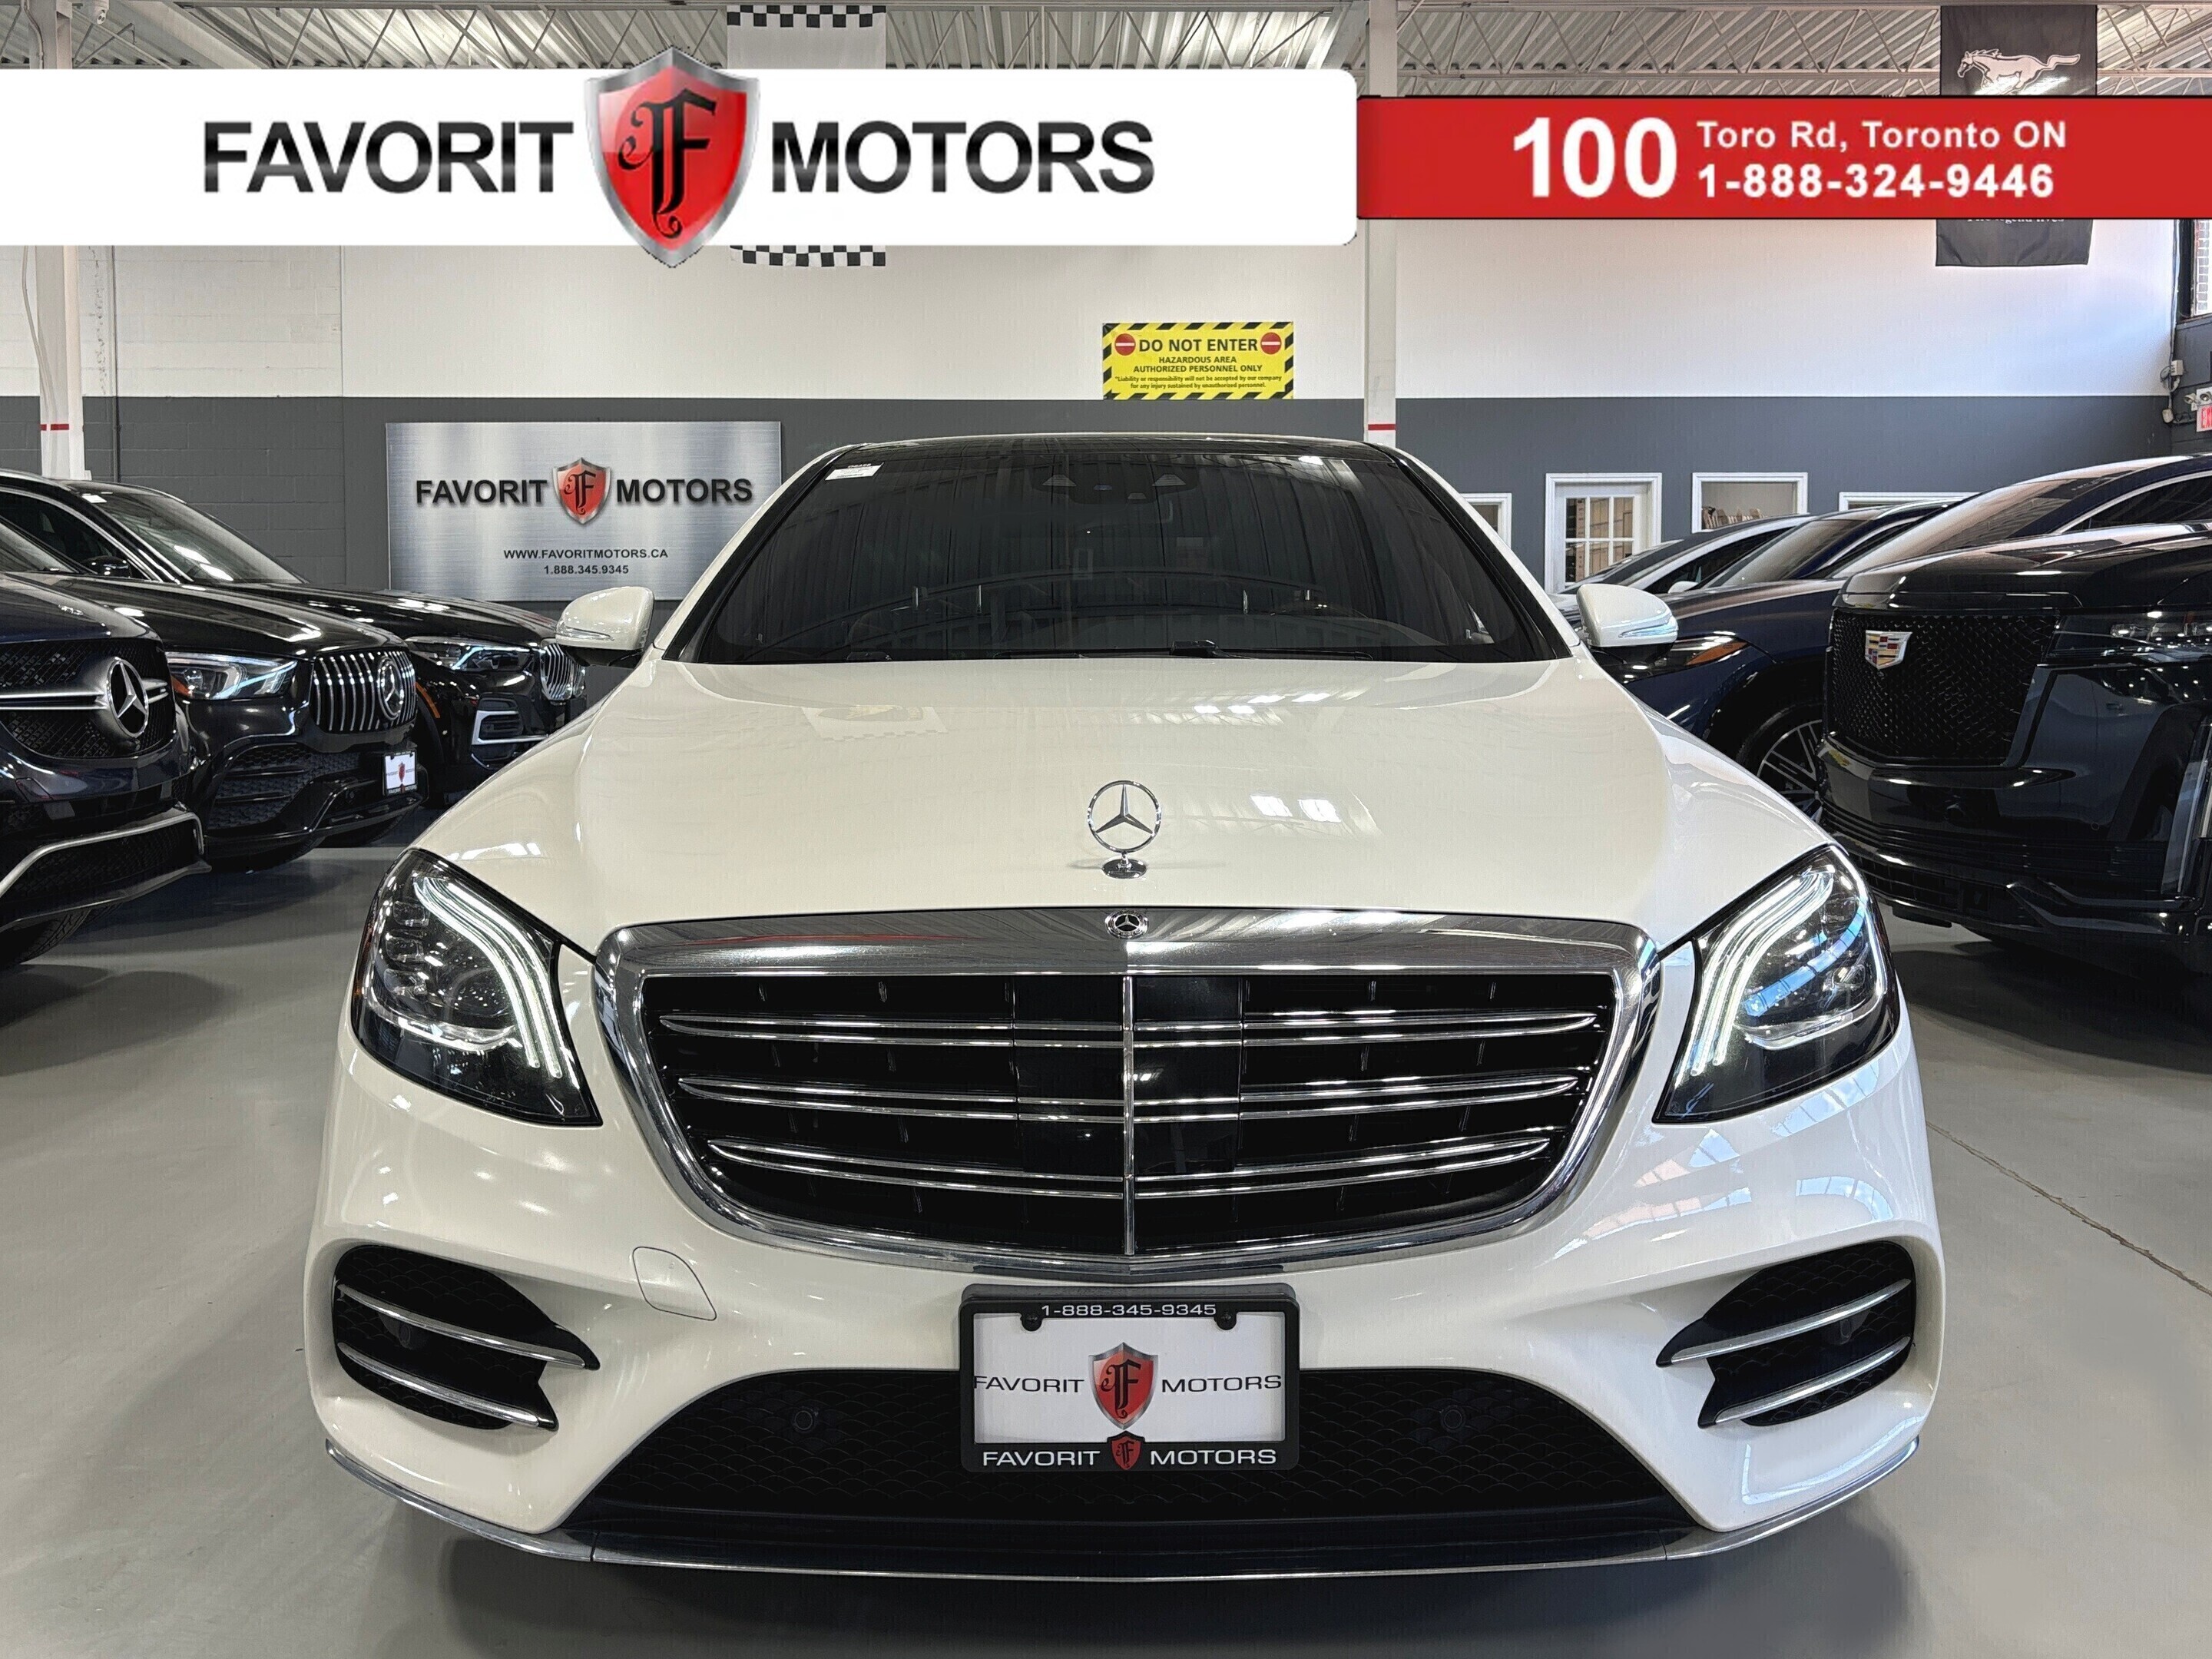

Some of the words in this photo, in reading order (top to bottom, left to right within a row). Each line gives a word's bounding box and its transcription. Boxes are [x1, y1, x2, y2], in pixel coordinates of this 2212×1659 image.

[1139, 339, 1163, 352] DO
[1169, 339, 1202, 352] NOT
[1207, 339, 1258, 351] ENTER
[416, 479, 548, 505] FAVORIT
[617, 478, 753, 504] MOTORS
[503, 548, 669, 560] WWW.FAVORITMOTORS.CA
[543, 565, 629, 575] 1.888.345.9345
[1041, 1304, 1217, 1316] 1-888-345-9345
[974, 1375, 1085, 1393] FAVORIT
[1162, 1374, 1283, 1392] MOTORS
[983, 1450, 1101, 1467] FAVORIT
[1151, 1449, 1277, 1466] MOTORS
